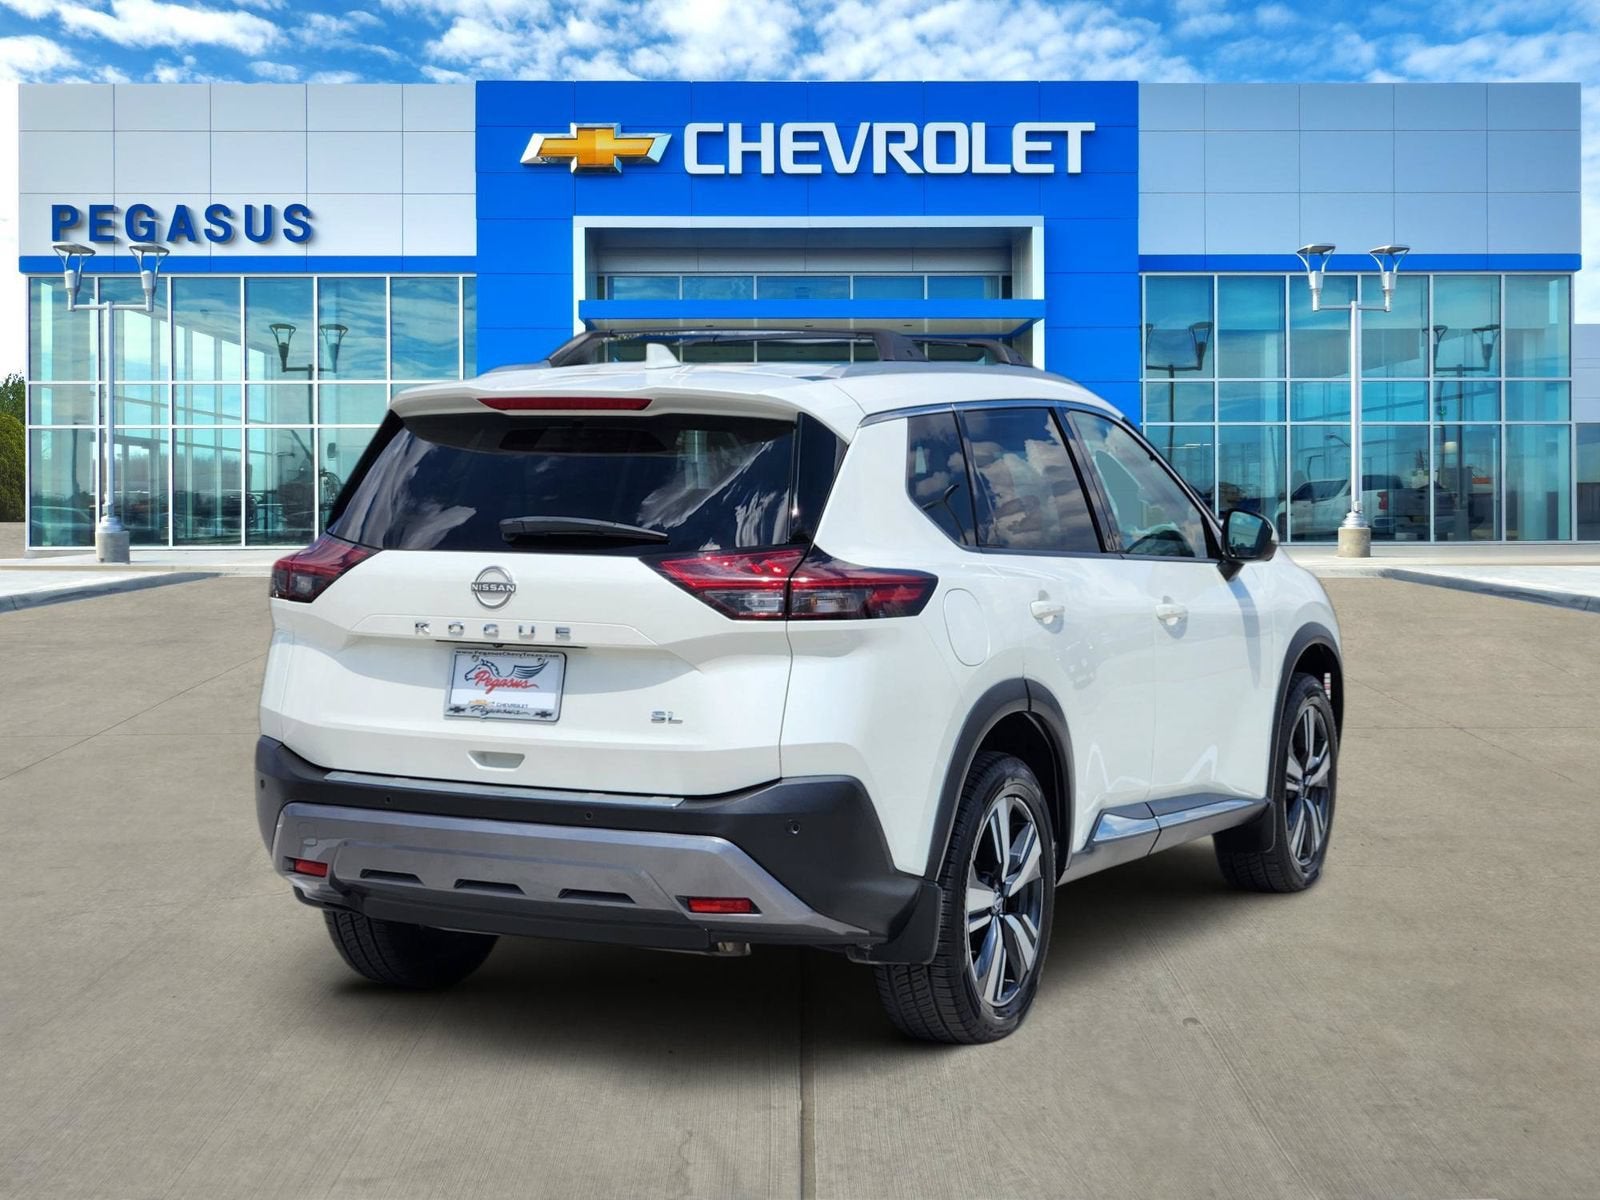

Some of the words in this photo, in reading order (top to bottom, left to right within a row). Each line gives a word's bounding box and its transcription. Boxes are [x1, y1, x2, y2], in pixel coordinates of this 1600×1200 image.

[683, 121, 1096, 175] CHEVROLET
[51, 203, 314, 243] PEGASUS
[471, 583, 516, 593] NISSAN
[415, 620, 571, 641] ROGUE
[474, 669, 539, 694] Pegasus
[650, 710, 684, 725] SL
